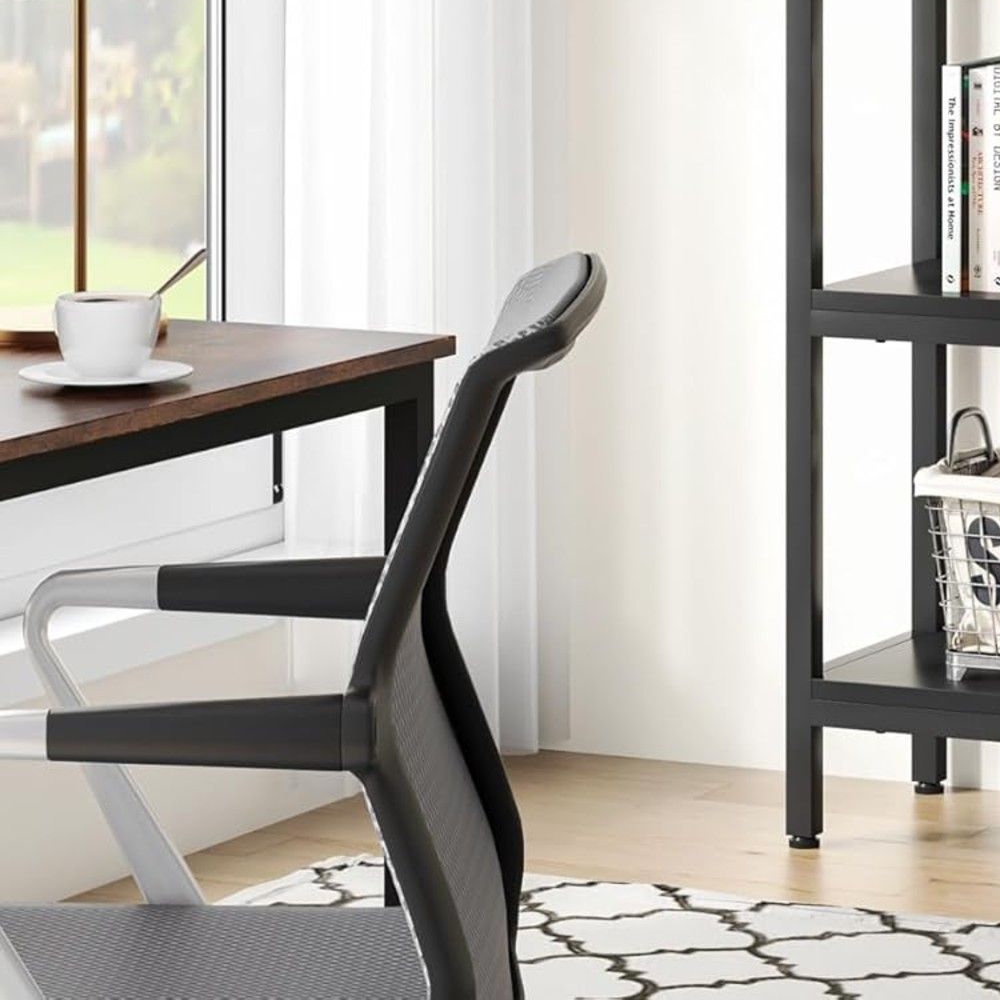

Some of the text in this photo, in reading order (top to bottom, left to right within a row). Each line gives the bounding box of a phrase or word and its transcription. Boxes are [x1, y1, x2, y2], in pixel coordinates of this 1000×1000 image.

[947, 97, 957, 241] The Impressionists at Home
